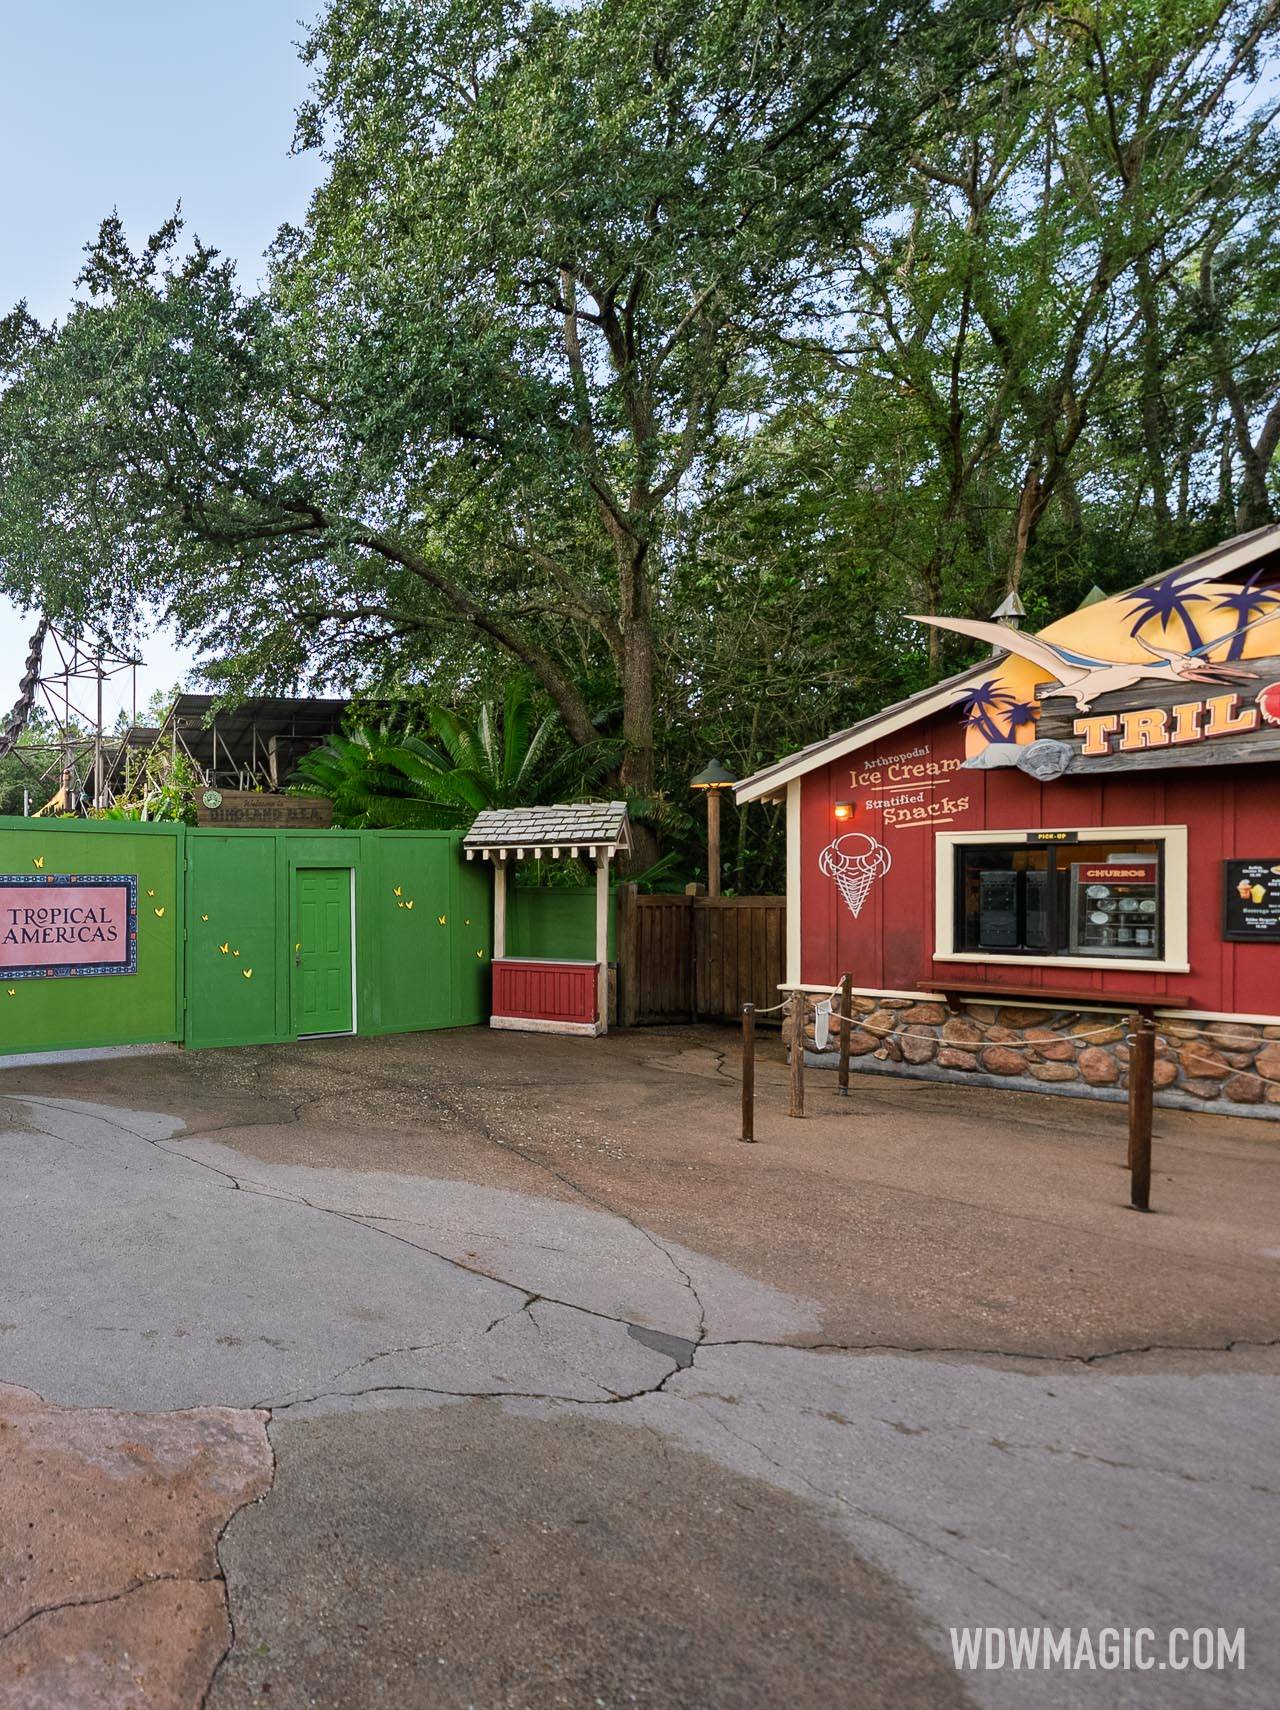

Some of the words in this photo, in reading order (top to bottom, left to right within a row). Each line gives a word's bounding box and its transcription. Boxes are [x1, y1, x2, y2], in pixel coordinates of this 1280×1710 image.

[864, 745, 930, 770] Arthropodal
[849, 771, 882, 789] Ice
[888, 758, 961, 781] Cream
[865, 792, 925, 810] Stratified
[883, 796, 969, 825] Snacks
[1086, 869, 1146, 878] CHURROS
[7, 907, 113, 929] TROPICAL
[2, 925, 118, 945] AMERICAS
